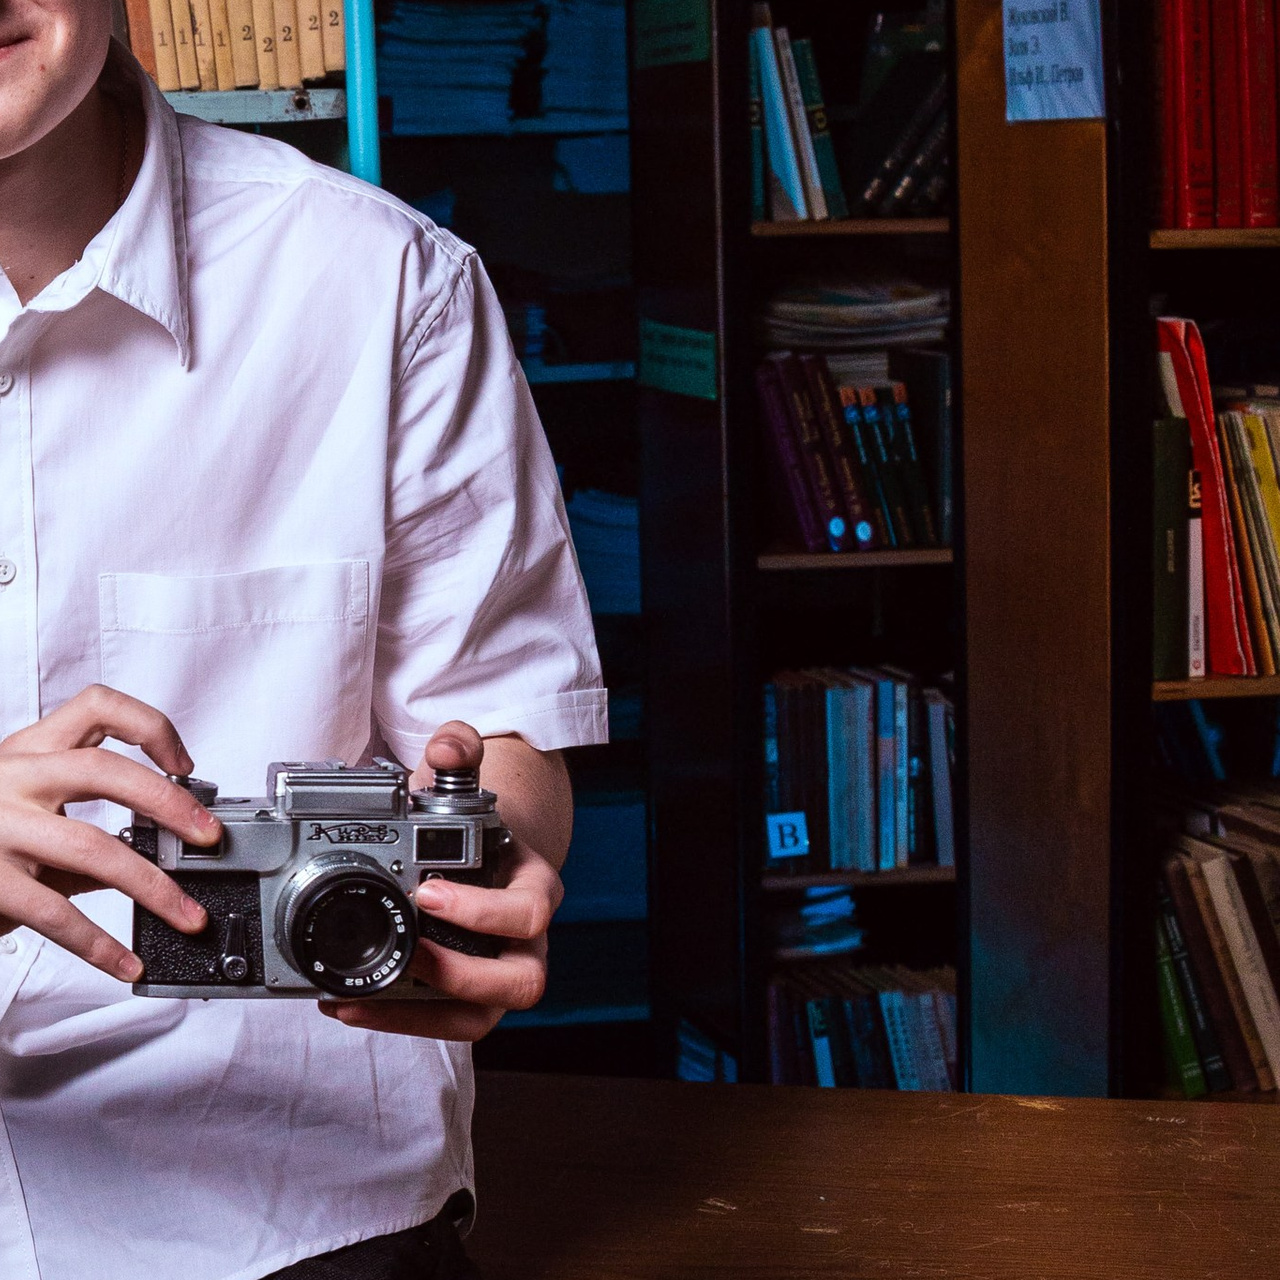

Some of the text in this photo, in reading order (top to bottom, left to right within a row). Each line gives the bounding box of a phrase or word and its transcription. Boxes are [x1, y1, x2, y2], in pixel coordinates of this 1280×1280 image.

[309, 15, 319, 30] 2
[329, 11, 339, 26] 2
[158, 30, 167, 47] 1
[179, 28, 188, 45] 1
[196, 29, 206, 47] 1
[217, 30, 226, 47] 1
[242, 25, 252, 41] 2
[282, 26, 292, 42] 2
[263, 36, 273, 52] 2
[776, 821, 800, 851] В
